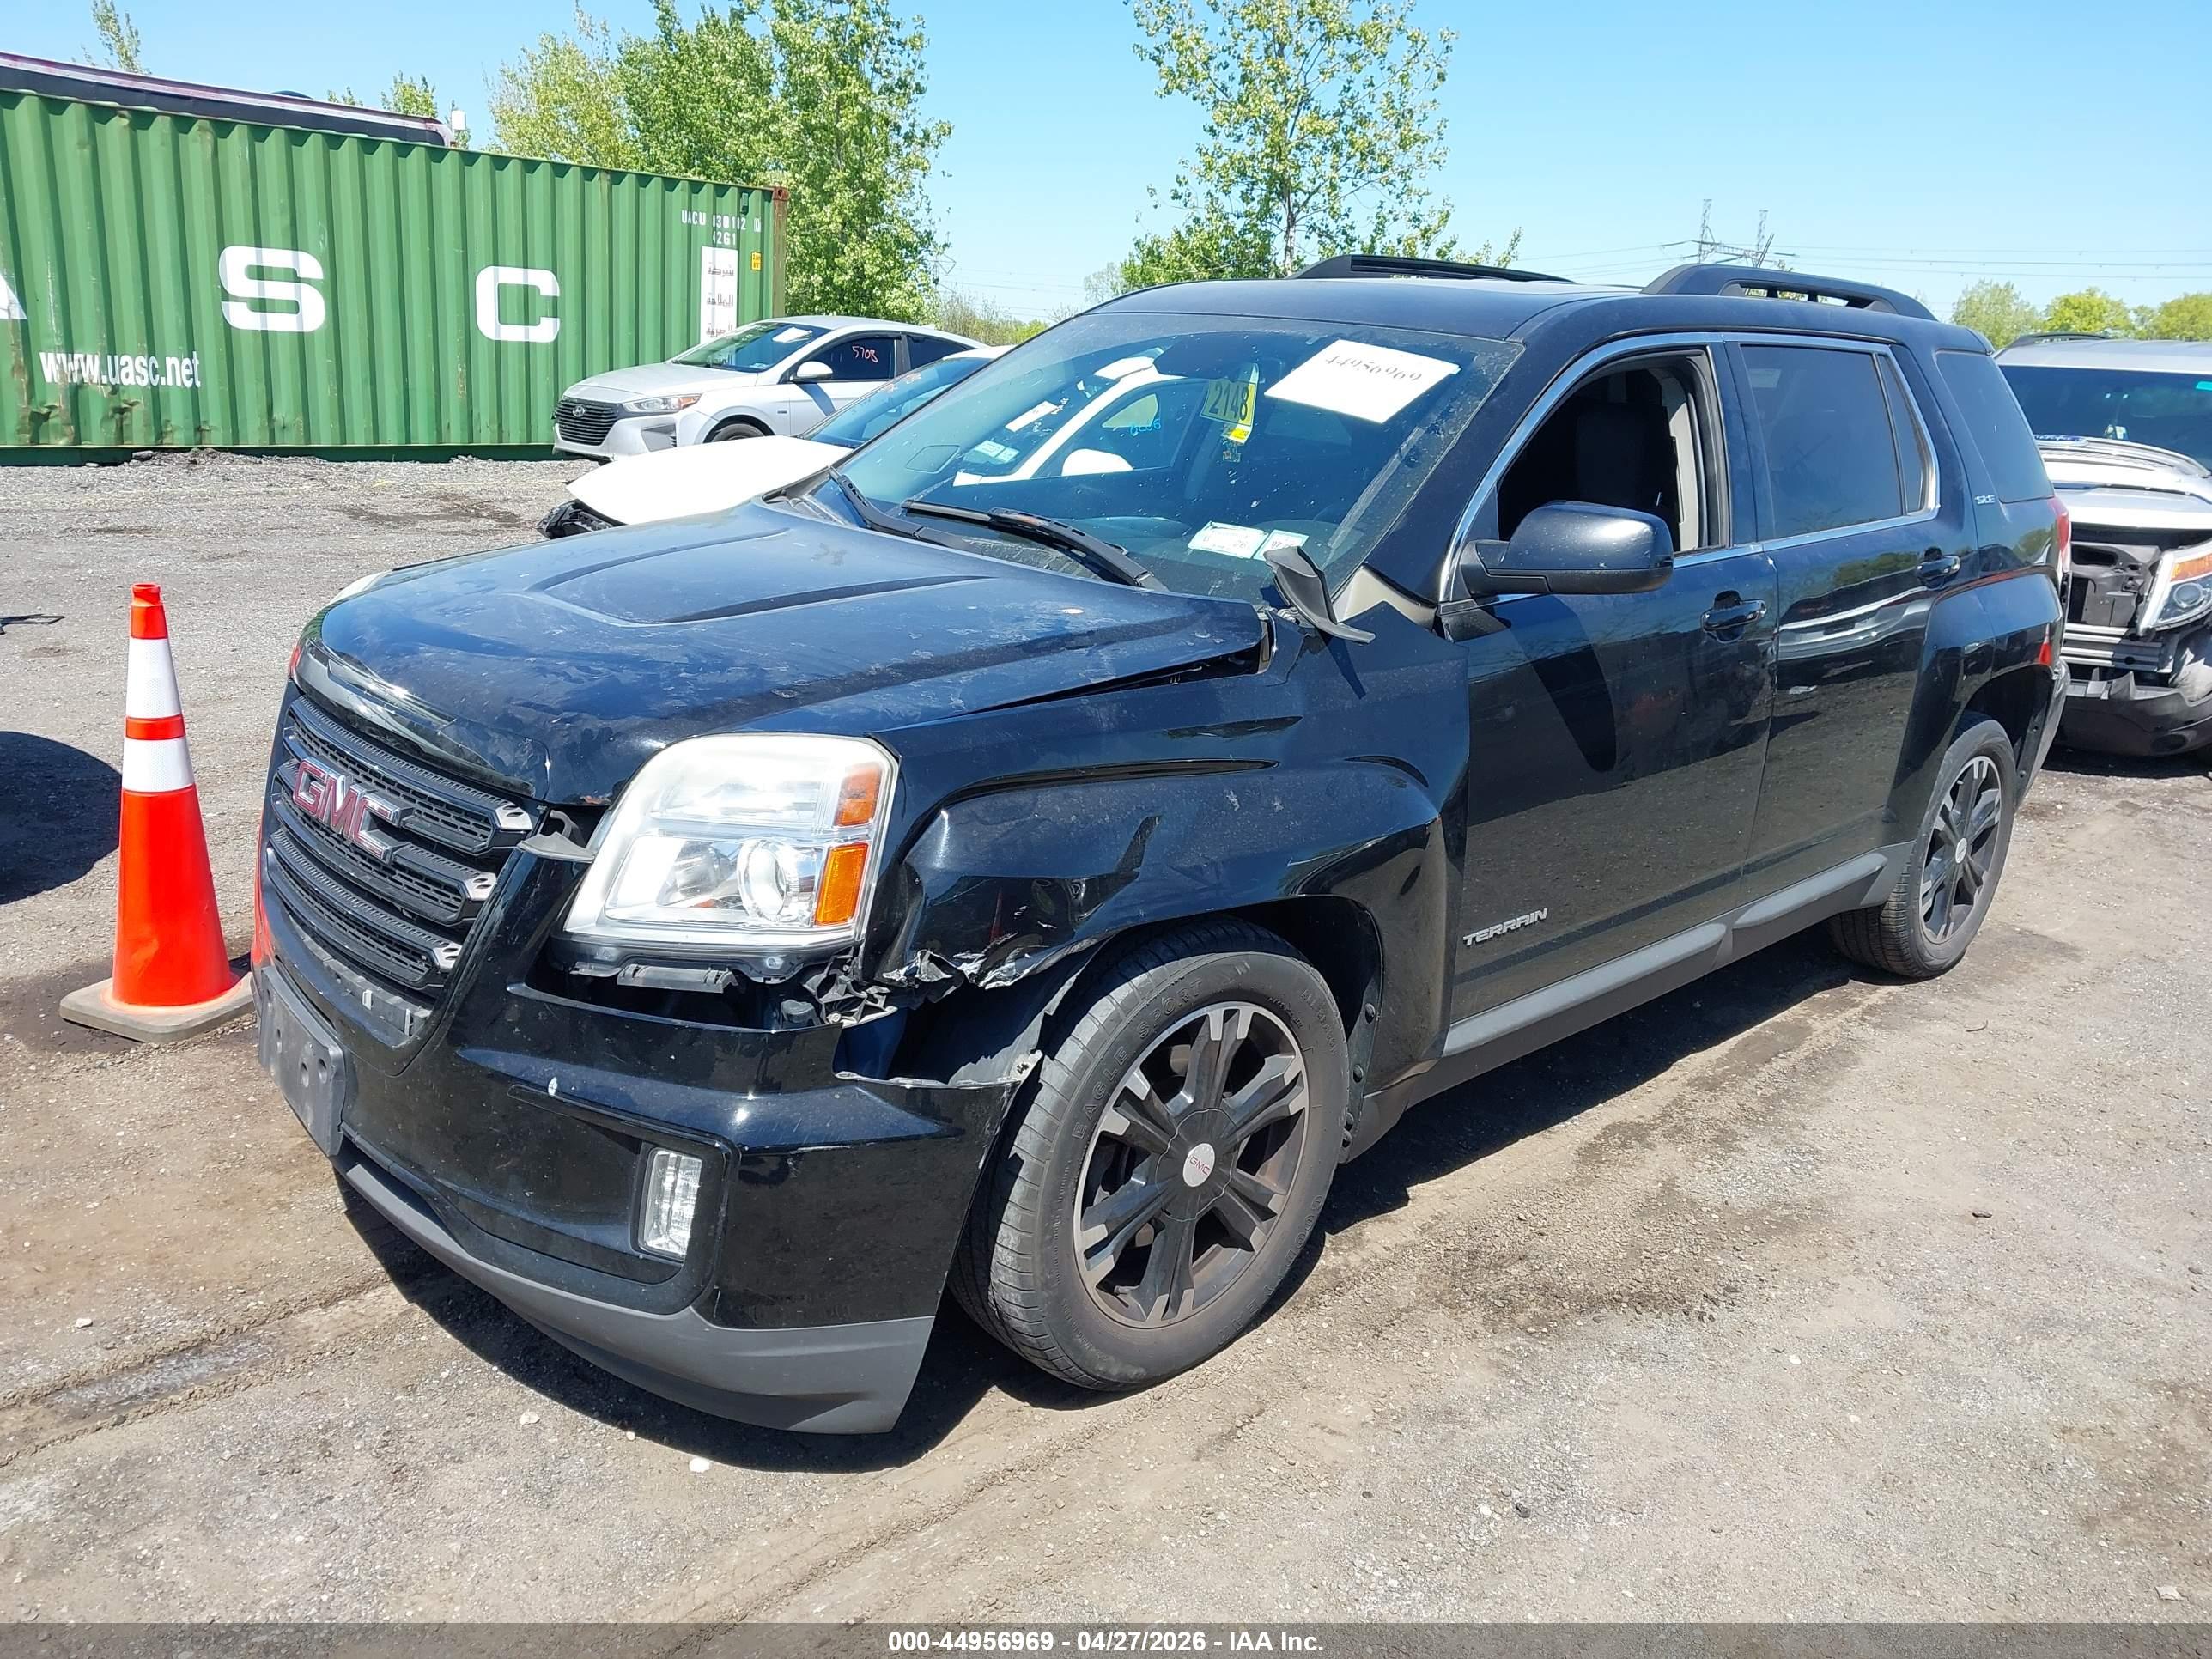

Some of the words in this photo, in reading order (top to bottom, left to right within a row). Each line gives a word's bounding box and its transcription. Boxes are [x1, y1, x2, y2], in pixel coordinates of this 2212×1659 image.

[681, 210, 707, 226] UACU
[40, 350, 201, 387] www.uasc.net
[1208, 381, 1249, 421] 2148
[293, 757, 400, 861] GMC
[1462, 908, 1548, 947] TERRAIN
[1072, 1047, 1127, 1141] EAGLE
[1138, 978, 1202, 1040] SPORT
[1189, 1155, 1211, 1176] GMC
